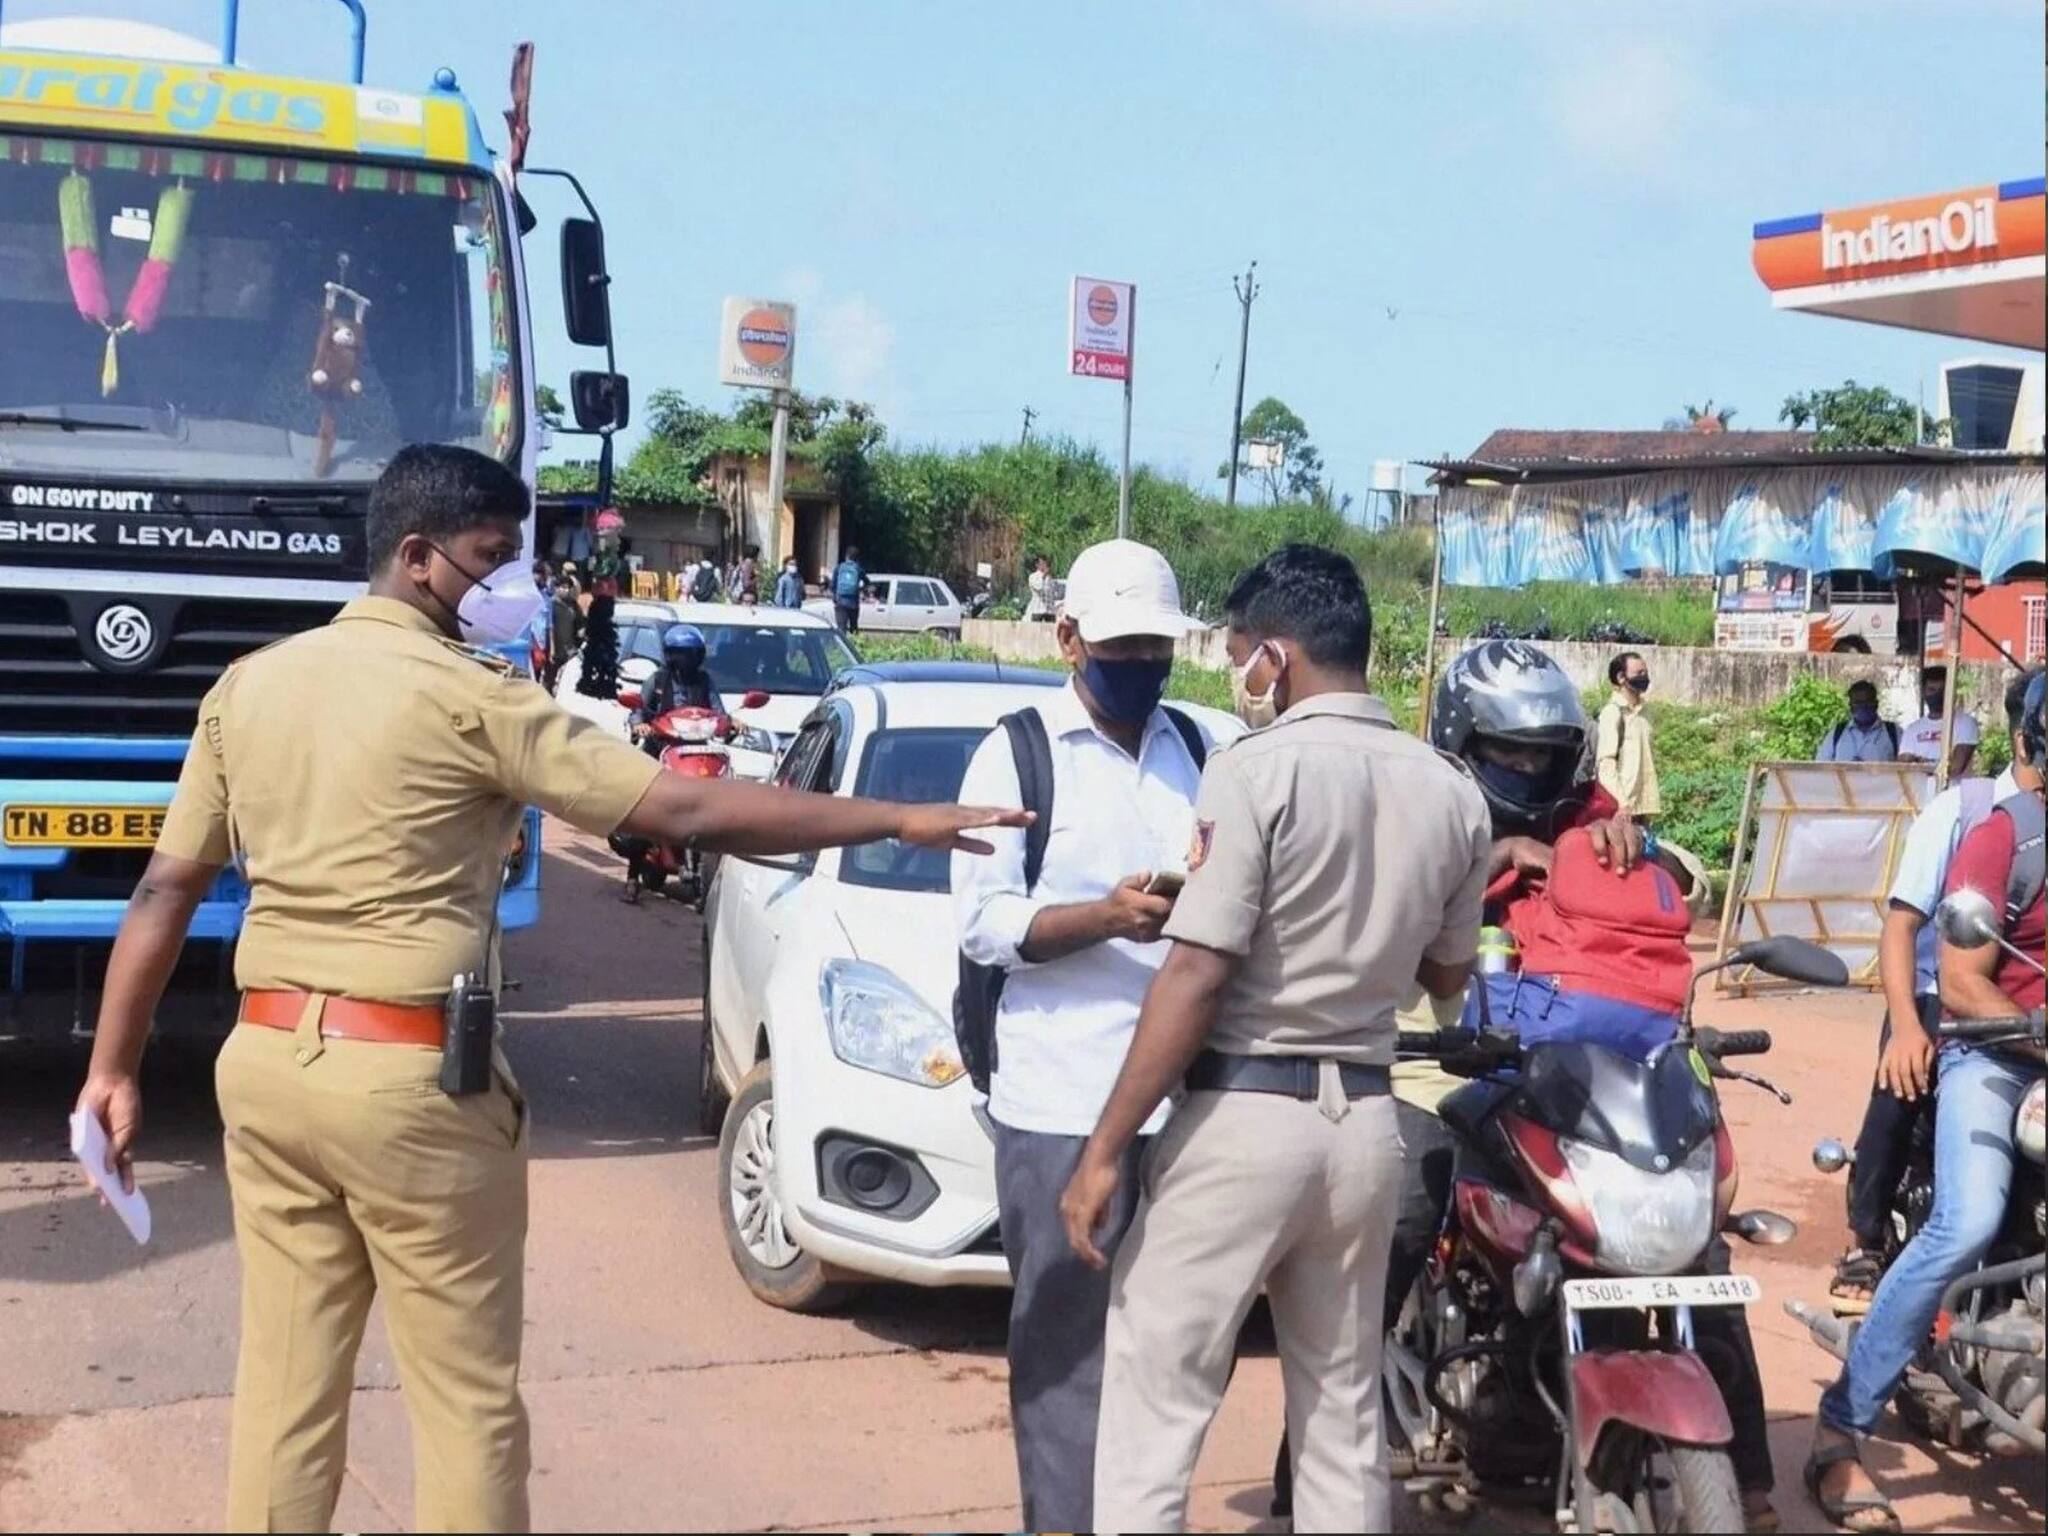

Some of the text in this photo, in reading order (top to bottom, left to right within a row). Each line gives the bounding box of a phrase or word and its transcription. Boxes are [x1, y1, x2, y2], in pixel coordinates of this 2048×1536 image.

[1821, 197, 1998, 270] IndianOil
[1075, 352, 1097, 375] 24
[12, 485, 154, 511] ON GOVT DUTY
[118, 525, 281, 549] LEYLAND
[287, 533, 341, 554] GAS
[9, 811, 48, 837] TN
[66, 812, 114, 837] 88
